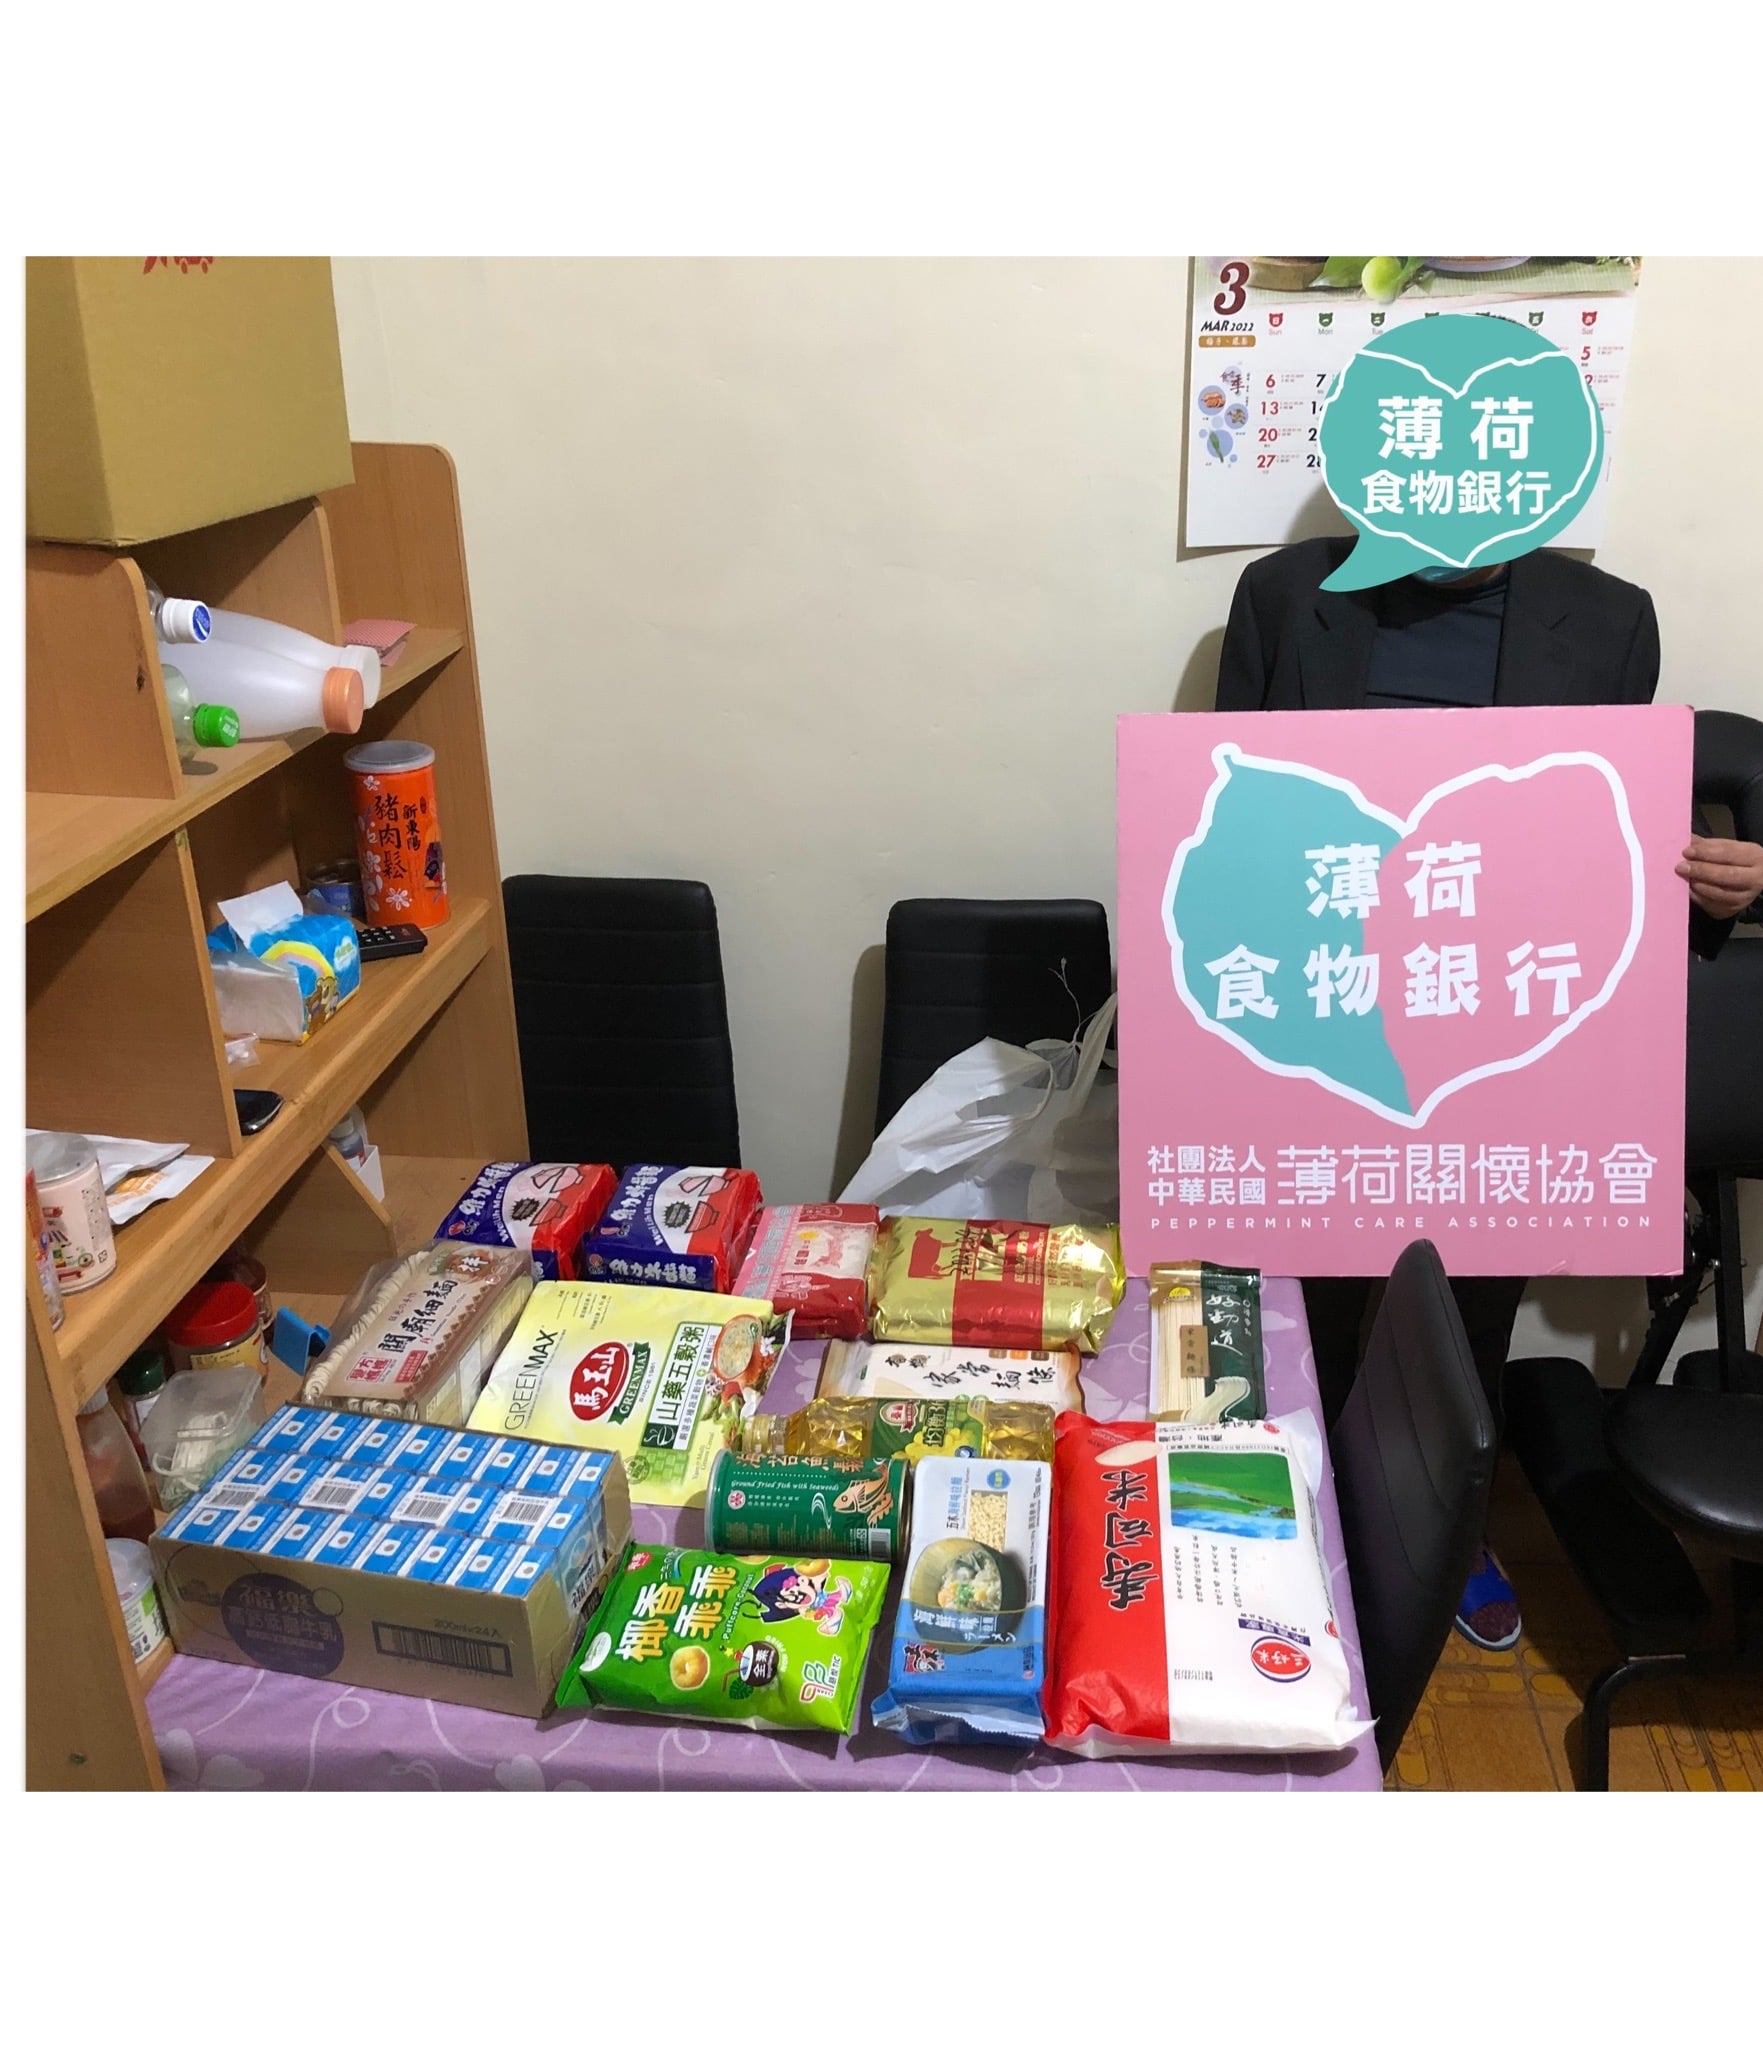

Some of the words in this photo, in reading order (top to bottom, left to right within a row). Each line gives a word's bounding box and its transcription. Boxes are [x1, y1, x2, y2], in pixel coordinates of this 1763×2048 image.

[1213, 262, 1249, 315] 3
[1200, 320, 1229, 332] MAR
[1230, 322, 1255, 332] 2022
[1581, 346, 1591, 361] 5
[1265, 374, 1276, 388] 6
[1316, 374, 1326, 388] 7
[1261, 401, 1279, 415] 13
[1258, 428, 1278, 442] 20
[1257, 454, 1277, 468] 27
[374, 793, 407, 879] 豬肉鬆
[1304, 840, 1482, 920] 薄荷
[1203, 940, 1582, 1020] 食物銀行
[1146, 1145, 1266, 1174] 社團法人
[1276, 1143, 1658, 1206] 薄荷關懷協會
[1147, 1178, 1265, 1207] 中華民國
[1151, 1217, 1332, 1230] PEPPERMINT
[1354, 1217, 1425, 1229] CARE
[1447, 1215, 1652, 1229] ASSOCIATION
[503, 1329, 560, 1431] GREENMAX
[574, 1346, 621, 1411] 馬玉山
[619, 1350, 650, 1415] GREENMAX
[674, 1564, 737, 1639] 乖乖
[615, 1583, 686, 1662] 椰香
[1255, 1649, 1305, 1667] 三好米
